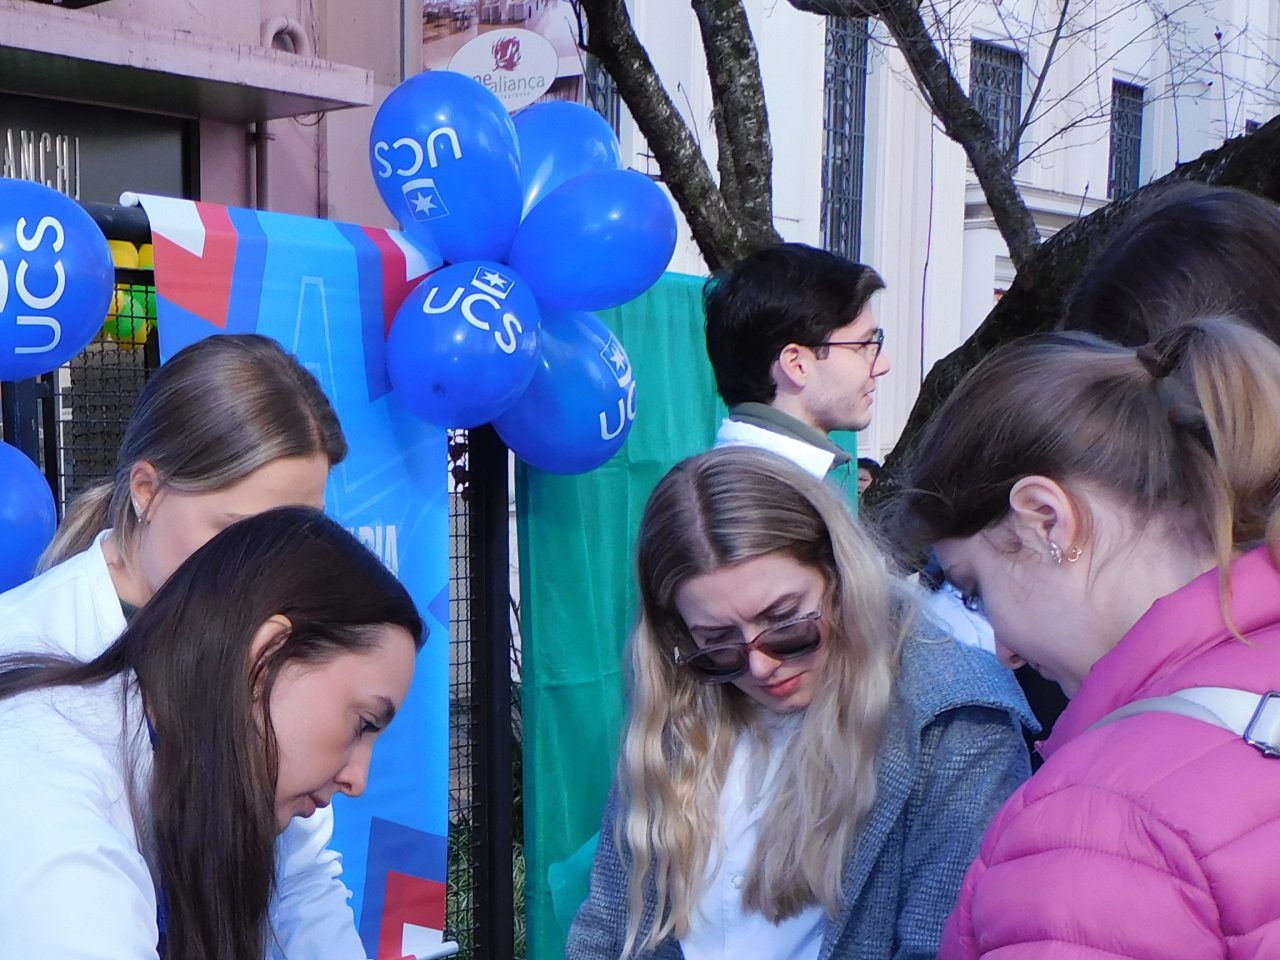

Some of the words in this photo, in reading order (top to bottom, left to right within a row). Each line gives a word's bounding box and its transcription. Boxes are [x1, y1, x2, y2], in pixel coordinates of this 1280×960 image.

[374, 127, 463, 179] UCS
[15, 215, 65, 354] UCS
[422, 287, 523, 354] UCS
